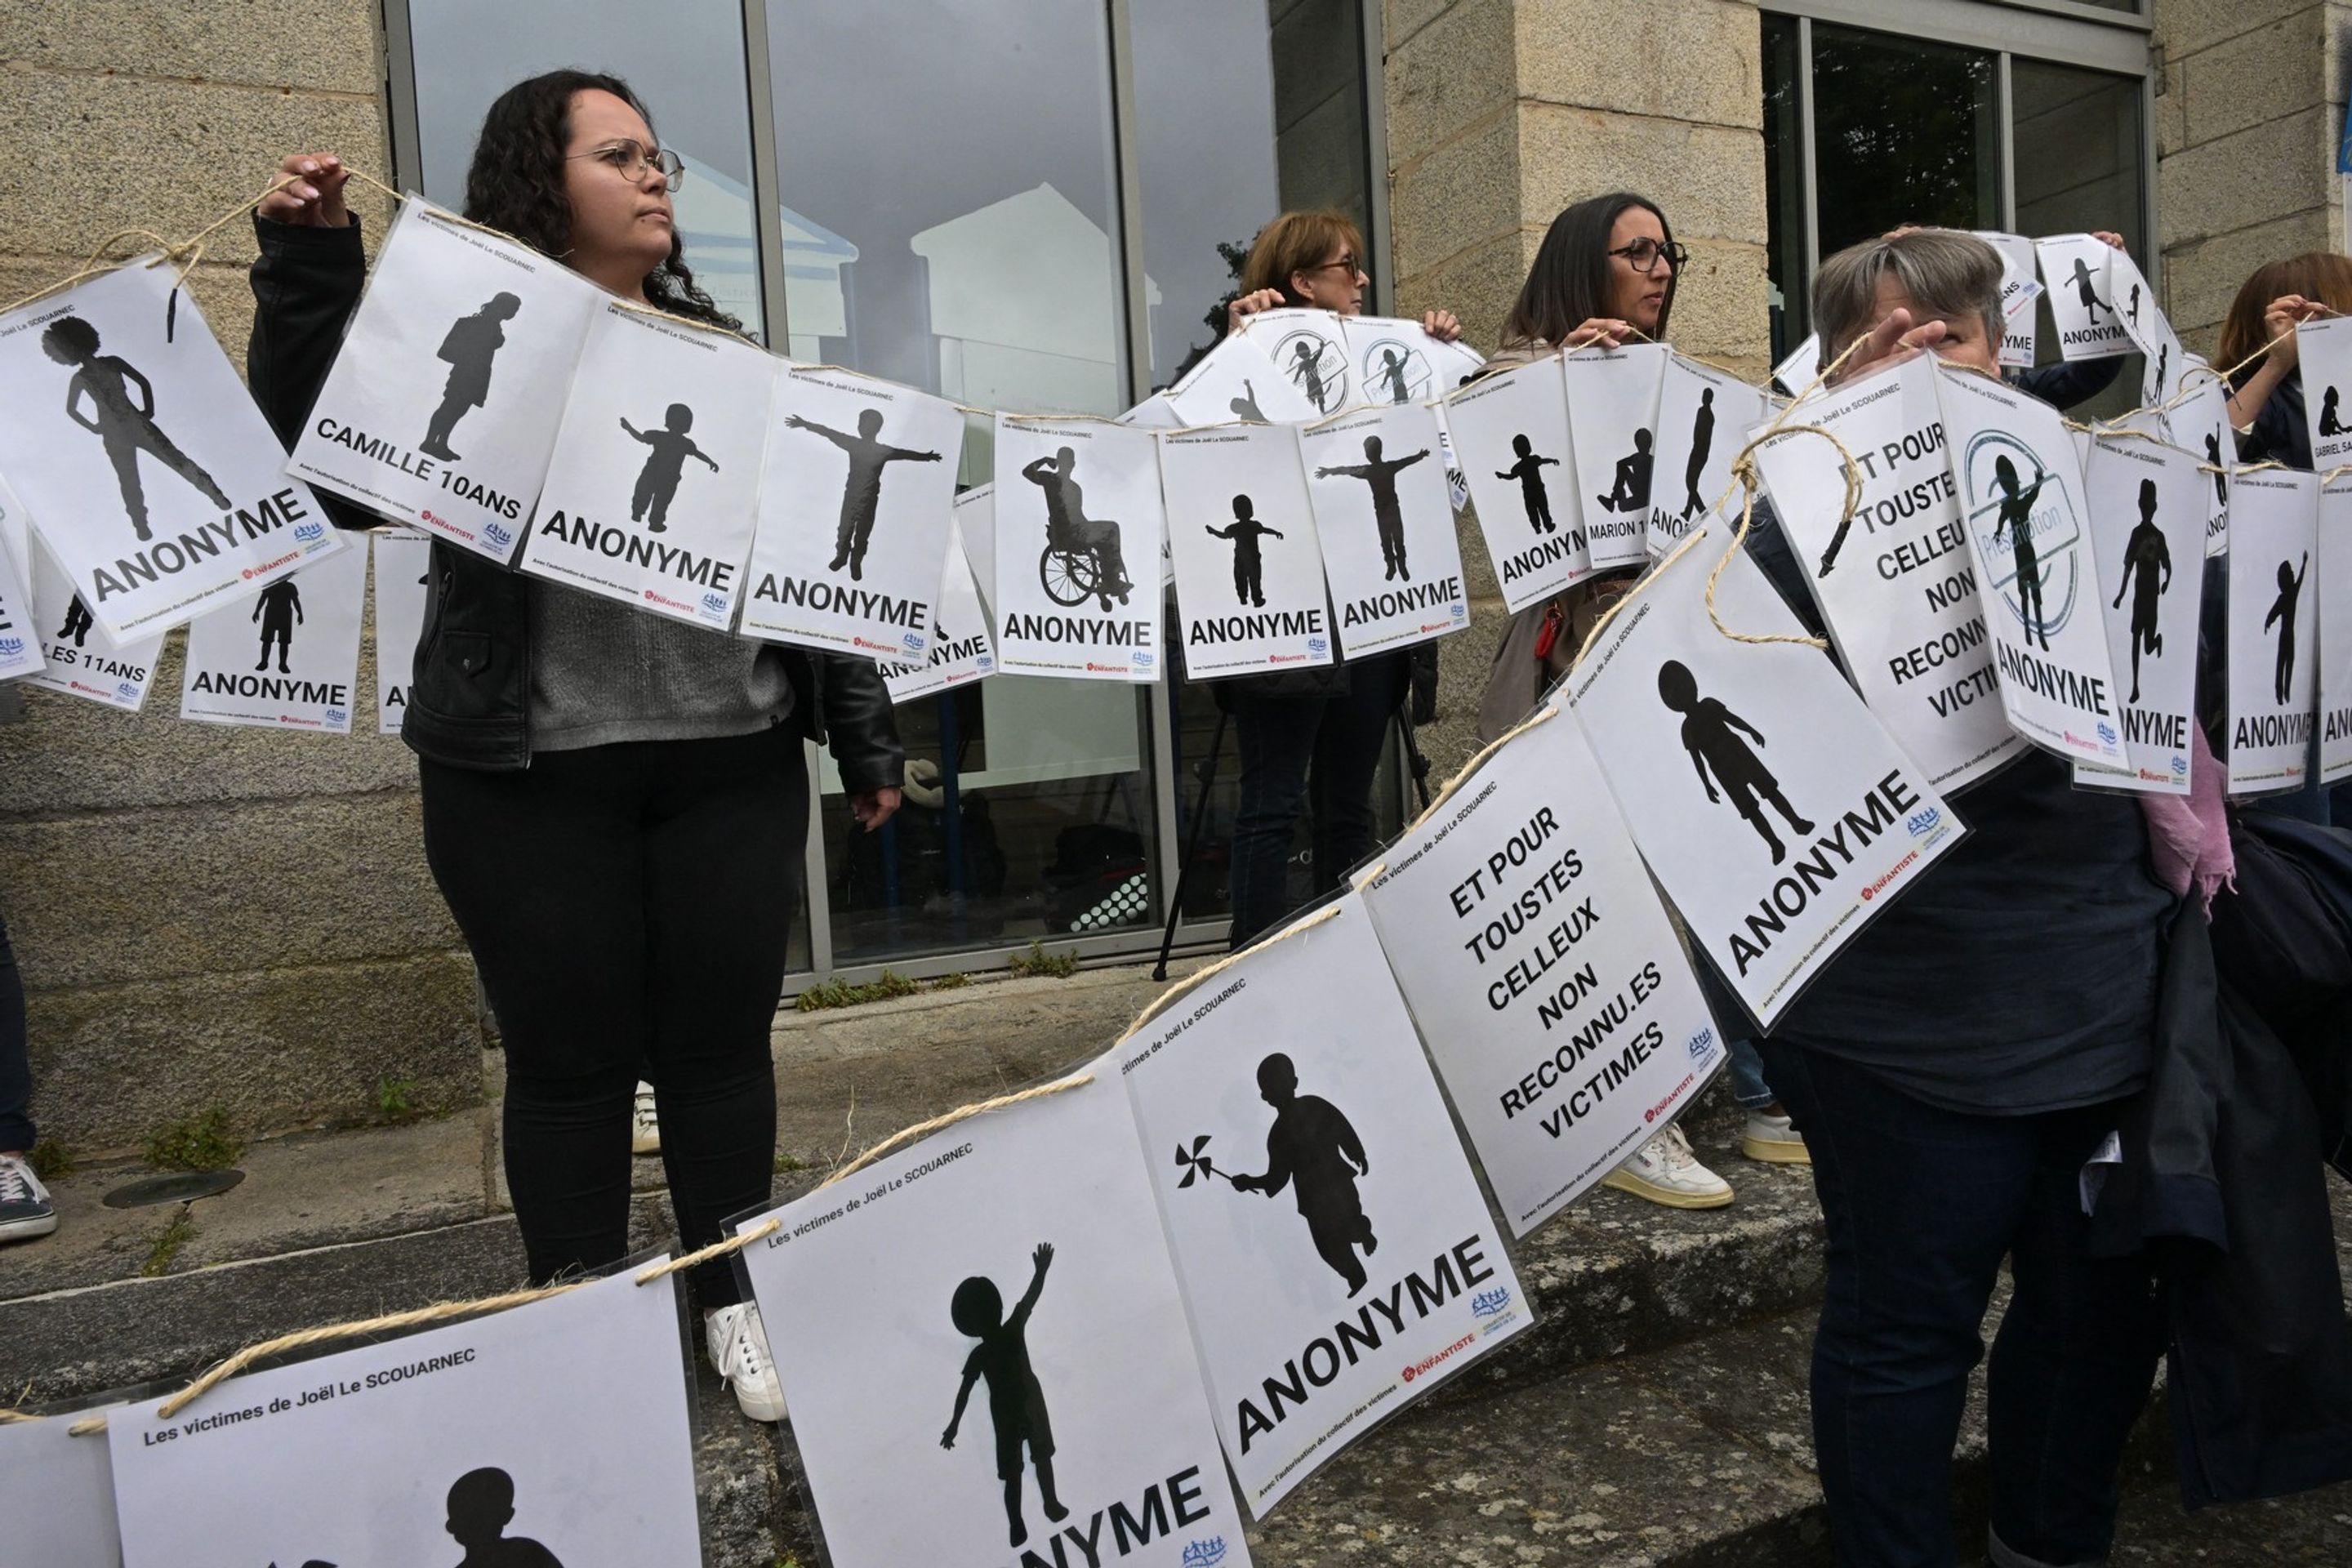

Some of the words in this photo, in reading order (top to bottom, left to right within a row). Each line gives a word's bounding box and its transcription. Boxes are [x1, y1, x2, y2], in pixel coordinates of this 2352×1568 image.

[416, 212, 430, 222] Les
[430, 220, 459, 237] victimes
[494, 249, 535, 273] SCOUARNEC
[2063, 325, 2125, 345] ANONYM
[1840, 407, 1851, 418] Le
[1851, 383, 1901, 410] SCOUARNEC
[317, 418, 434, 480] CAMILLE
[441, 470, 520, 519] 10ANS
[1882, 421, 1946, 470] POUR
[430, 515, 474, 541] ENFANTISTE
[1589, 521, 1636, 540] MARION
[1855, 470, 1956, 535] TOUSTE
[93, 487, 308, 602] ANONYME
[540, 510, 734, 592] ANONYME
[1503, 526, 1587, 583] ANONYM
[1877, 517, 1966, 580] CELLEU
[753, 573, 927, 630] ANONYME
[1343, 576, 1460, 628] ANONYME
[1925, 567, 1977, 613] NON
[880, 635, 987, 680] ANNYME
[1004, 612, 1150, 646] ANONYME
[1190, 608, 1322, 645] ANONYME
[1569, 697, 1577, 708] es
[1576, 671, 1597, 698] victimes
[1597, 662, 1604, 673] de
[1612, 640, 1620, 651] Le
[1619, 603, 1650, 643] SCOUARNEC
[1889, 614, 1986, 684] RECONN
[84, 654, 145, 681] 11ANS
[191, 670, 346, 706] ANONYME
[1927, 663, 1998, 718] VICTI
[1997, 638, 2109, 716] ANONYME
[2127, 708, 2186, 749] NYME
[1370, 875, 1388, 889] Les
[1388, 850, 1423, 878] victimes
[1423, 841, 1432, 853] de
[1447, 819, 1457, 831] Le
[1456, 781, 1496, 822] SCOUARNEC
[1449, 868, 1485, 918] ET
[1487, 806, 1559, 884] POUR
[1728, 768, 1920, 978] ANONYME
[1870, 850, 1918, 893] ENFANTISTE
[1464, 849, 1582, 964] TOUSTES
[1487, 896, 1600, 1010] CELLEUX
[1762, 993, 1775, 1008] Avec
[1802, 954, 1810, 962] du
[1808, 932, 1829, 956] collectif
[1828, 924, 1838, 935] des
[1838, 904, 1860, 925] victimes
[1121, 1049, 1150, 1075] times
[1151, 1040, 1162, 1053] de
[1164, 1024, 1182, 1044] Joël
[1181, 1018, 1193, 1029] Le
[1193, 978, 1245, 1020] SCOUARNEC
[1537, 962, 1597, 1030] NON
[1499, 961, 1660, 1119] RECONNU.ES
[1539, 1021, 1663, 1138] VICTIMES
[1651, 1072, 1694, 1116] ENFANTISTE
[766, 1232, 791, 1249] Les
[793, 1208, 844, 1236] victimes
[846, 1200, 860, 1212] de
[863, 1183, 886, 1204] Joël
[888, 1178, 902, 1191] Le
[904, 1143, 973, 1183] SCOUARNEC
[1521, 1208, 1537, 1221] Avec
[1575, 1173, 1584, 1182] du
[1584, 1152, 1607, 1175] collectif
[1607, 1145, 1619, 1156] des
[1618, 1125, 1642, 1147] victimes
[1237, 1233, 1494, 1456] ANONYME
[1412, 1333, 1475, 1375] ENFANTISTE
[144, 1428, 178, 1446] Les
[183, 1405, 263, 1435] victimes
[269, 1397, 291, 1413] de
[296, 1383, 334, 1406] Joël
[339, 1381, 360, 1396] Le
[365, 1348, 474, 1388] SCOUARNEC
[1258, 1480, 1275, 1498] Avec
[1274, 1443, 1316, 1481] l'autorisation
[1316, 1435, 1326, 1446] du
[1325, 1412, 1353, 1437] collectif
[1353, 1405, 1367, 1417] des
[1367, 1384, 1396, 1406] victimes
[1021, 1465, 1210, 1568] NYME
